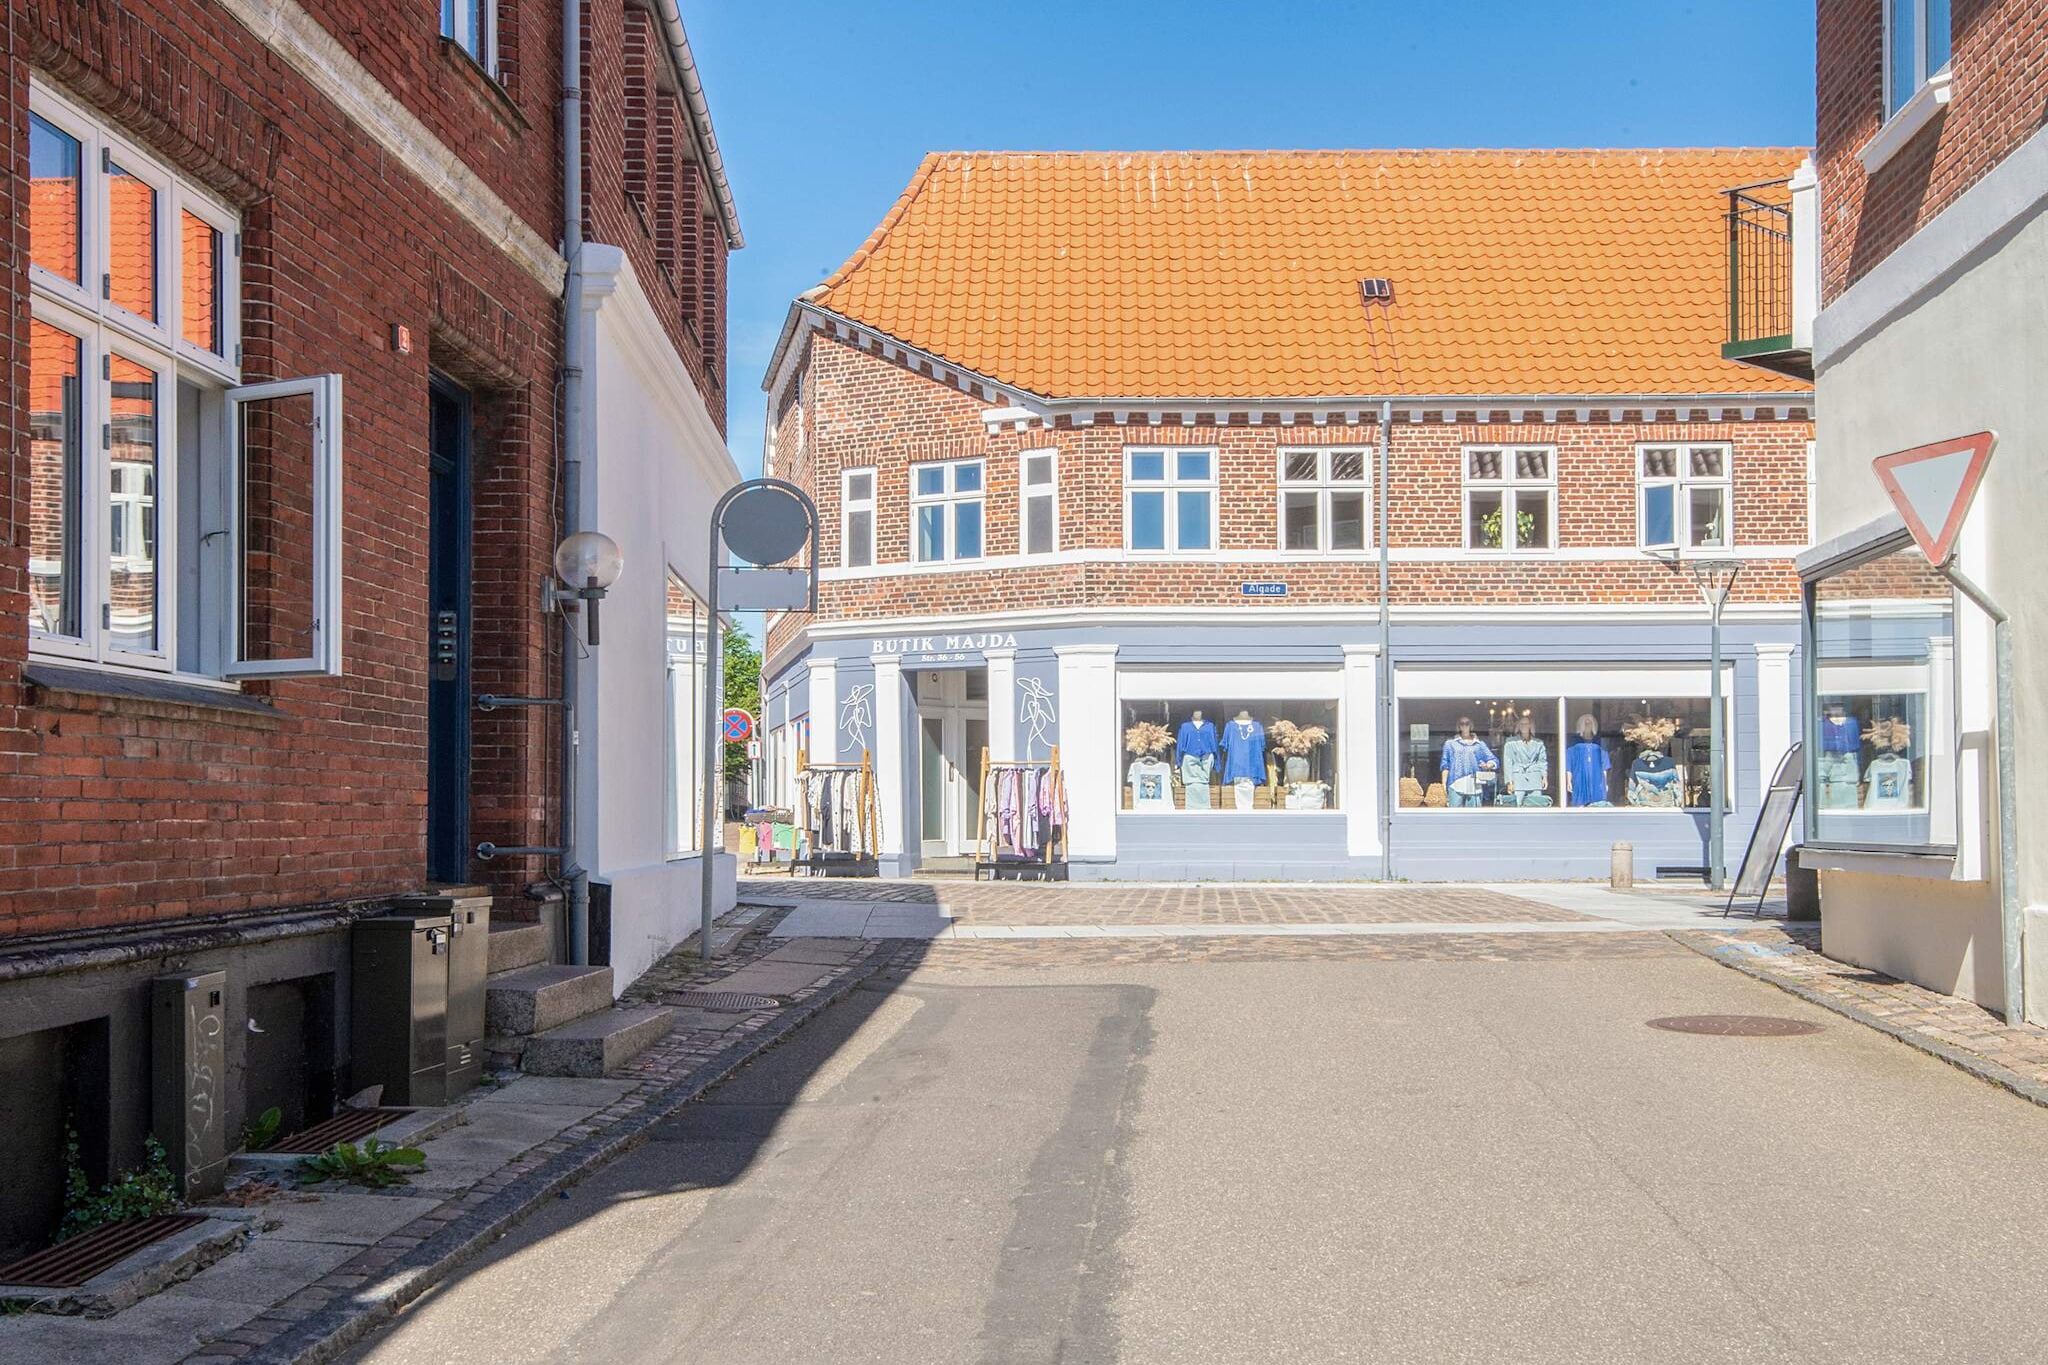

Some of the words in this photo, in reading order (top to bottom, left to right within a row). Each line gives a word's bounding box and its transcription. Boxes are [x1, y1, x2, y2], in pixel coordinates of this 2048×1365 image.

[1248, 584, 1281, 594] Algade
[872, 637, 934, 653] BUTIK
[946, 633, 1018, 650] MAJDA
